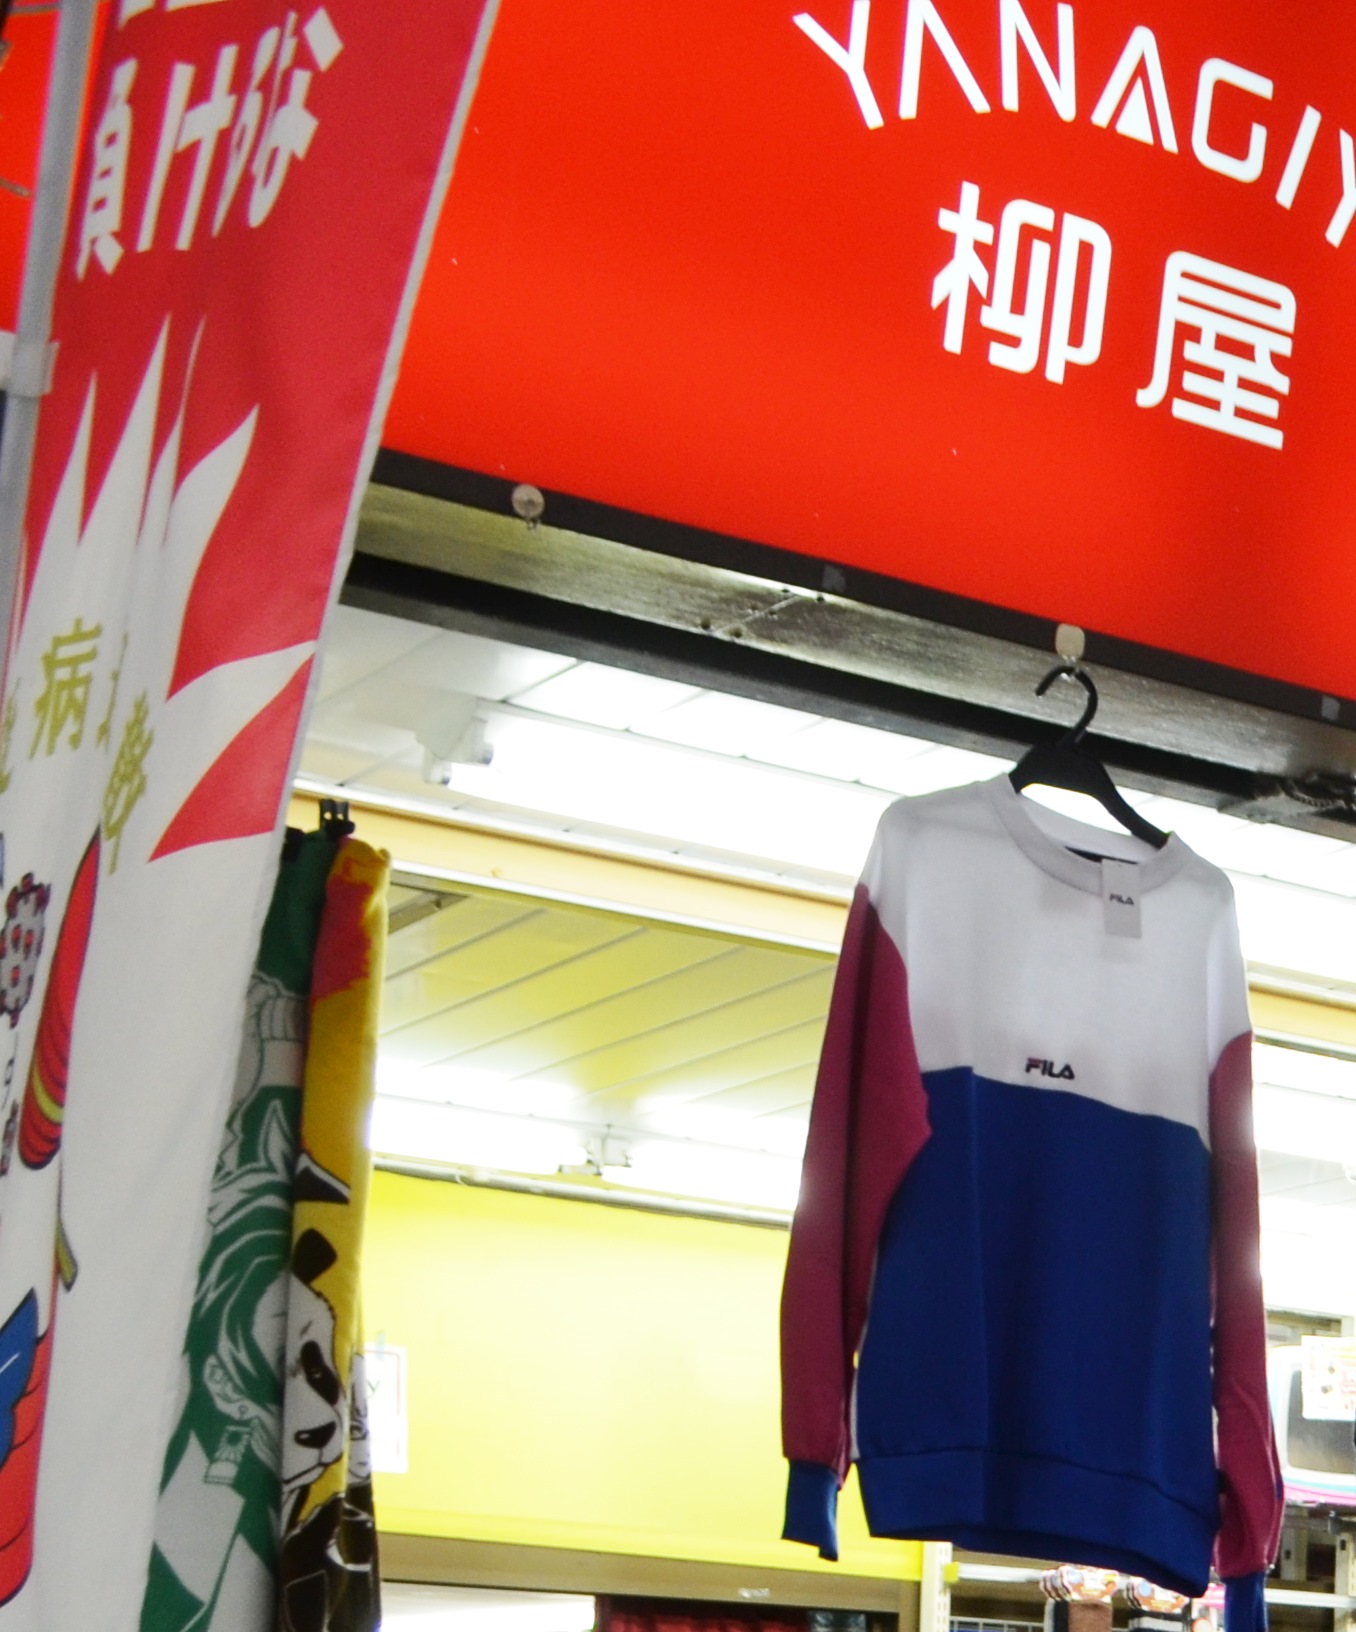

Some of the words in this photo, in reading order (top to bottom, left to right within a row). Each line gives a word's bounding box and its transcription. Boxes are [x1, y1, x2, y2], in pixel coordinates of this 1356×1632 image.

[931, 181, 1297, 450] 柳屋
[1109, 893, 1135, 905] FILA
[1025, 1057, 1076, 1080] FILA
